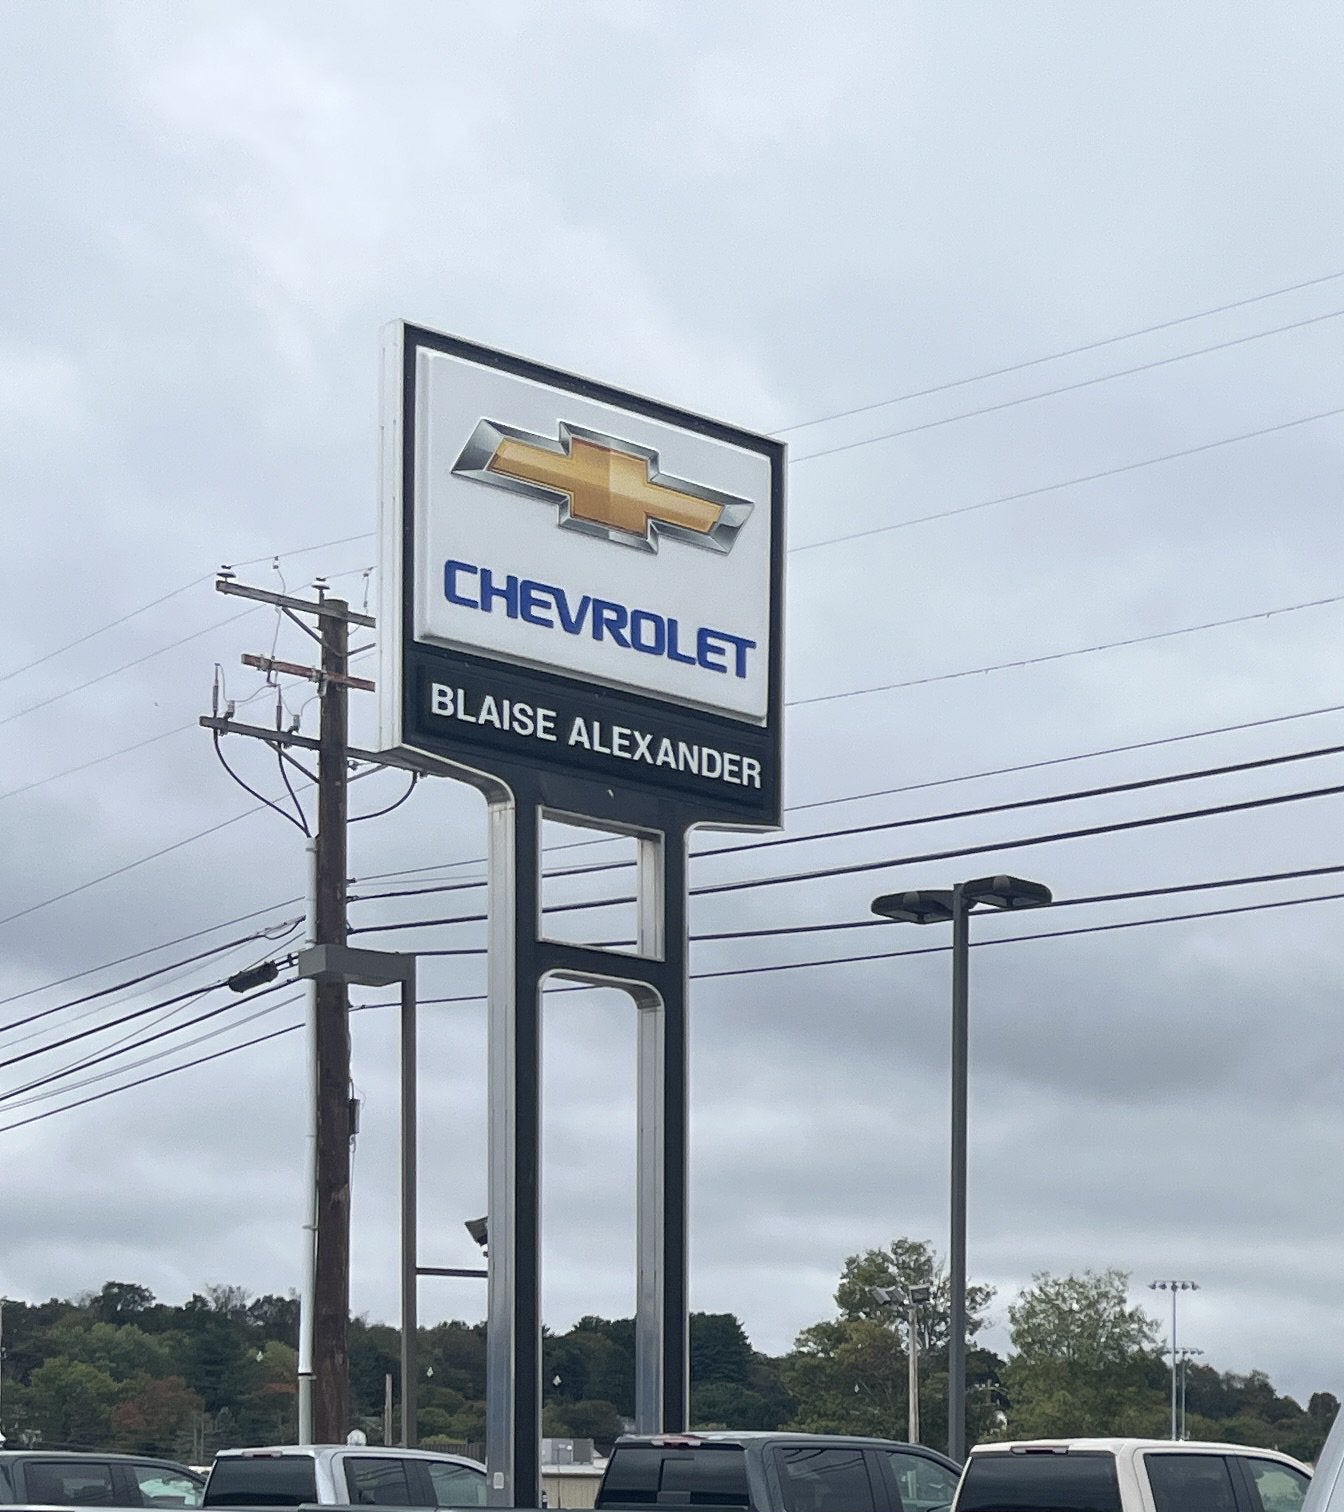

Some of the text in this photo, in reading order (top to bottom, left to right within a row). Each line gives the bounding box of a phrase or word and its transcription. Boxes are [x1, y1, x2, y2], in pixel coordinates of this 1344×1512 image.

[444, 559, 756, 679] CHEVROLET
[430, 683, 762, 789] BLAISE ALEXANDER
